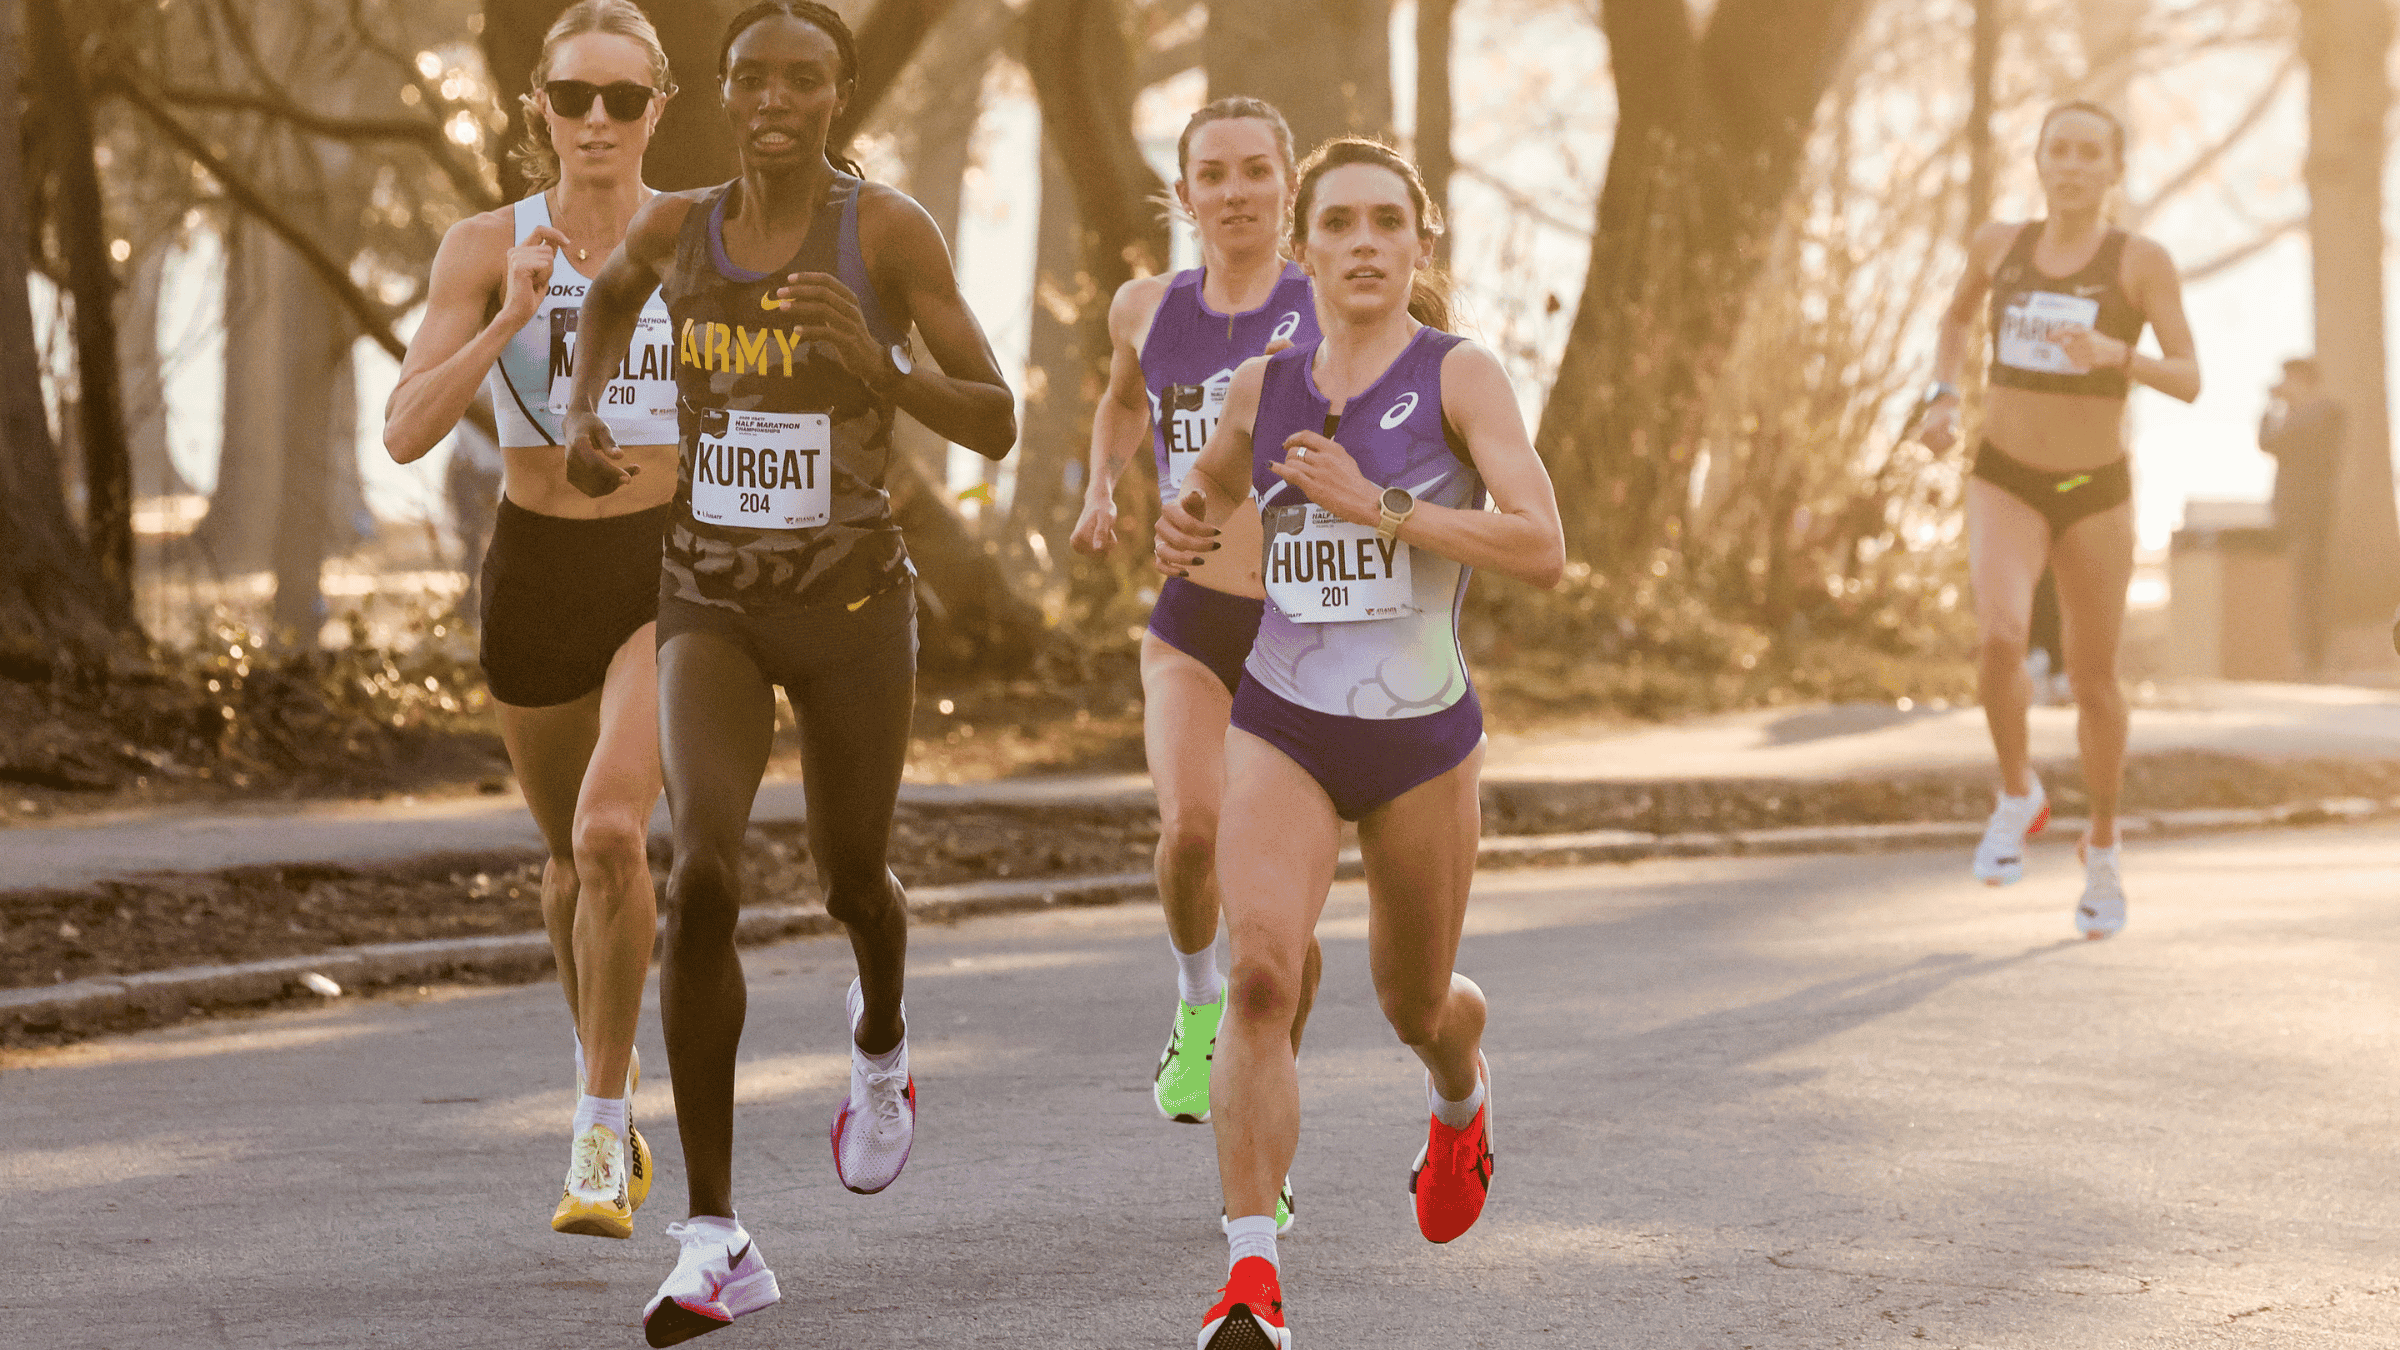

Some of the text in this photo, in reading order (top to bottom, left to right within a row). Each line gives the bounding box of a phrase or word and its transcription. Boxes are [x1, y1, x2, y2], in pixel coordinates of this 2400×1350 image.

[681, 318, 801, 378] ARMY
[608, 385, 635, 405] 210
[756, 421, 800, 430] MARATHON
[699, 442, 820, 489] KURGAT
[740, 493, 770, 513] 204
[1272, 538, 1397, 583] HURLEY
[1321, 586, 1348, 607] 201
